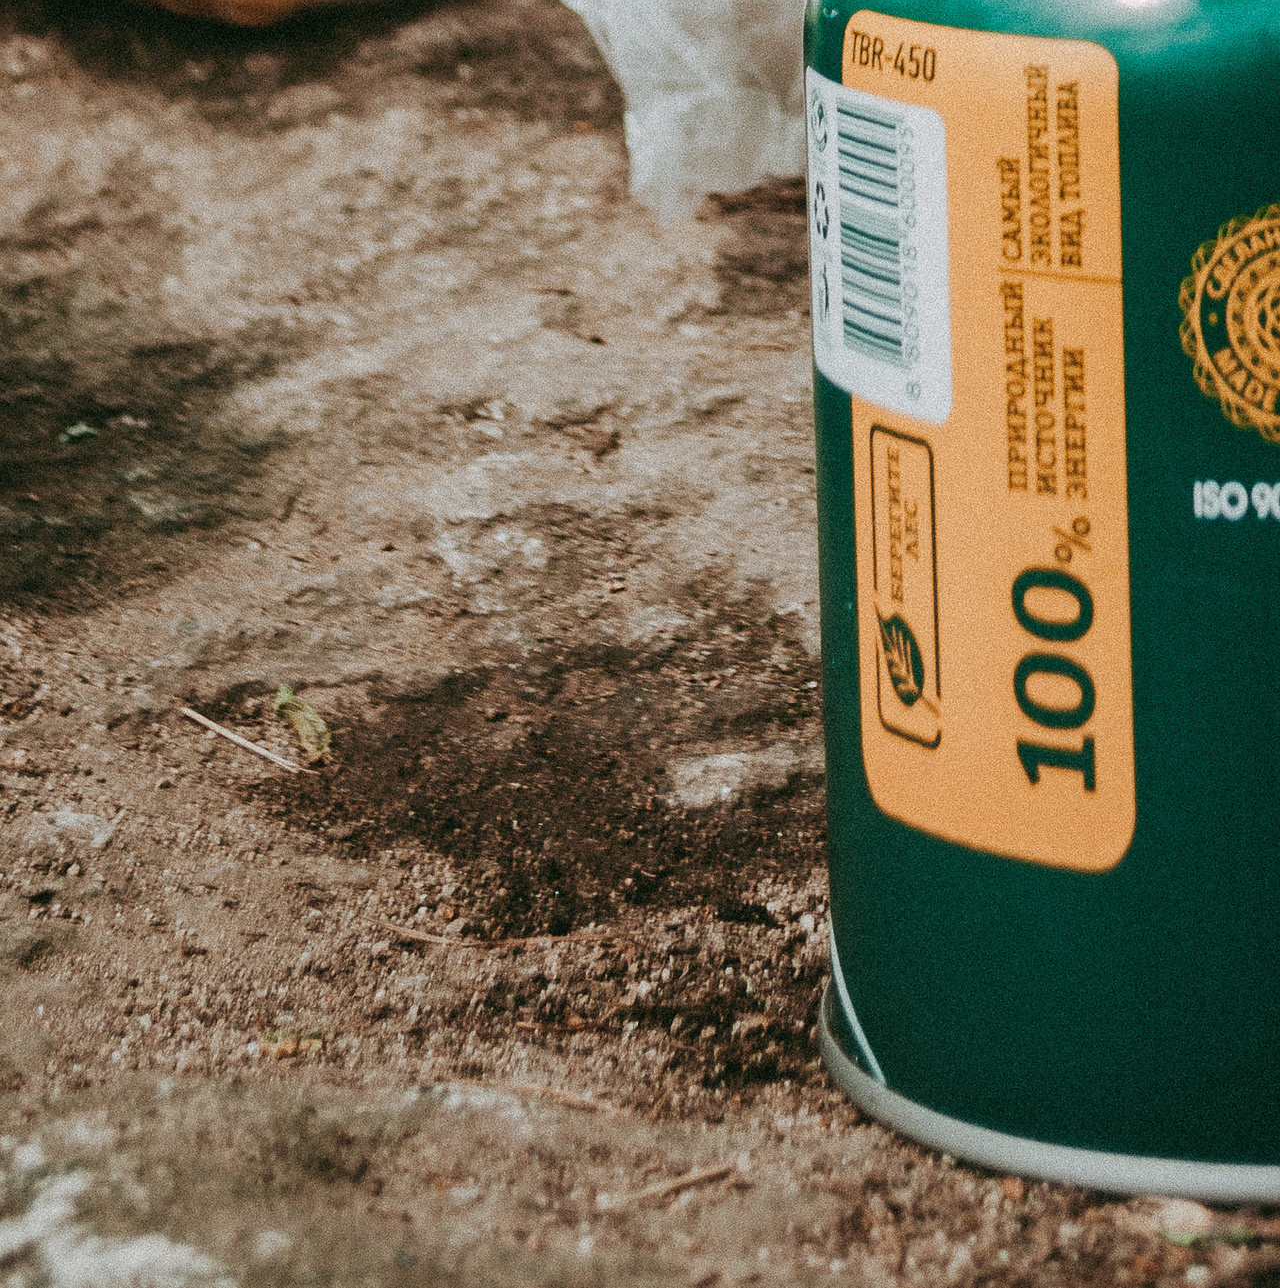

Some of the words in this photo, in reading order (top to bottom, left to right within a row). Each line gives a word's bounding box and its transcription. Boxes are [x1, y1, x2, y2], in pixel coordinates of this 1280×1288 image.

[850, 30, 938, 82] TBR-450
[1023, 63, 1052, 269] ЭКОЛОГИЧНЫЙ
[1057, 80, 1080, 200] ТОПЛИВА
[997, 156, 1022, 263] САМЫЙ
[1060, 208, 1086, 268] ВИД
[1000, 282, 1029, 493] ПРИРОДНЫЙ
[1032, 316, 1057, 499] ИСТОЧНИК
[1062, 347, 1089, 502] ЭНЕРГИИ
[886, 446, 904, 605] БЕРЕГИТЕ
[1193, 481, 1249, 521] ISO
